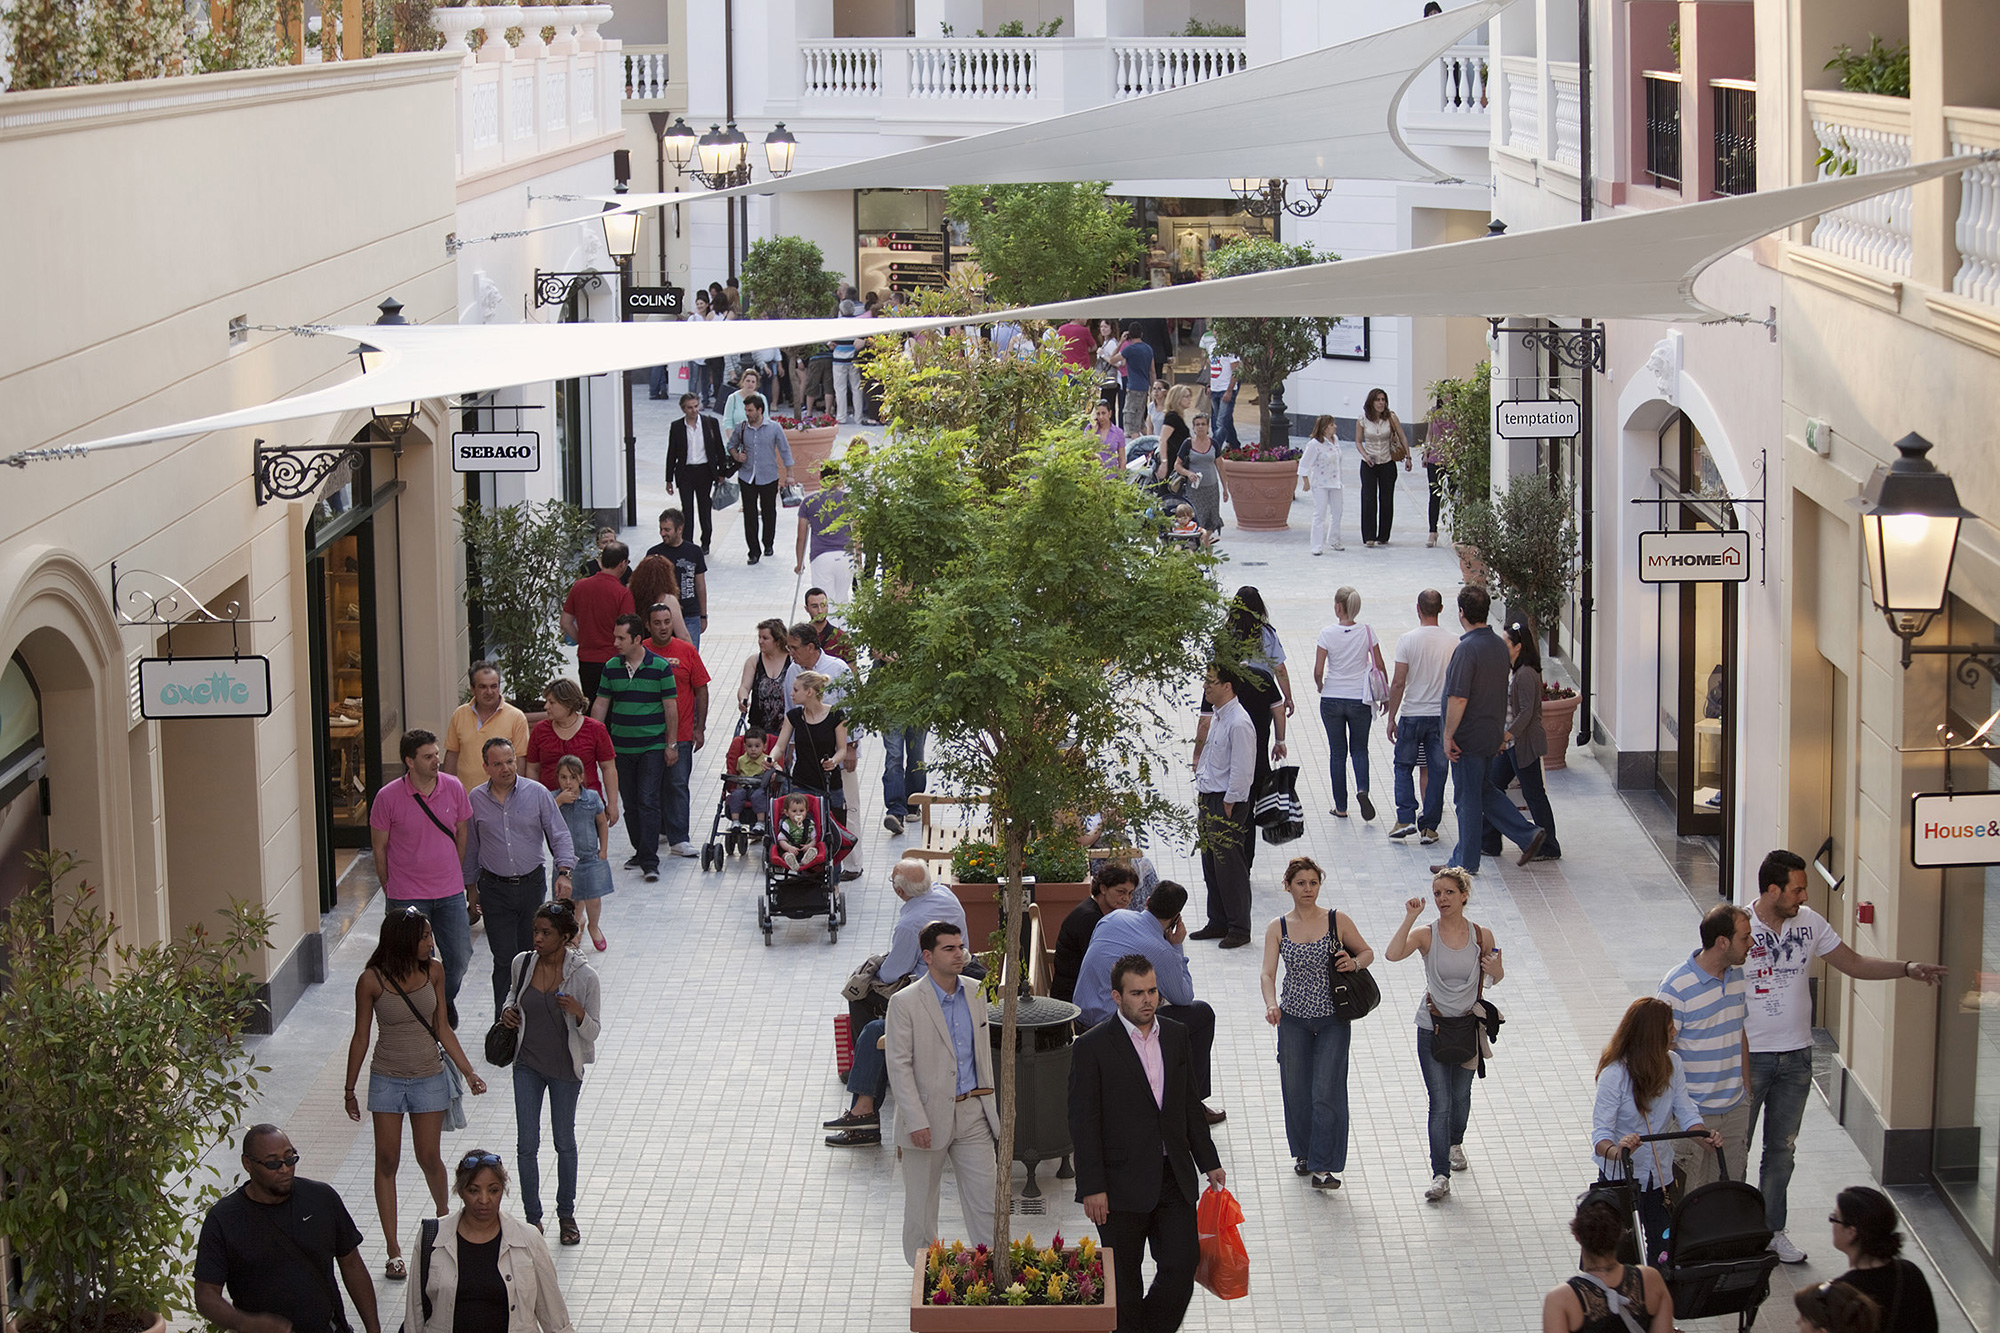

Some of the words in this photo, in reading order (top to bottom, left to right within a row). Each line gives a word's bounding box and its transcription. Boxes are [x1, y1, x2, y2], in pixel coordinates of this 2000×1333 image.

[629, 293, 676, 307] COLIN'S
[1505, 412, 1573, 427] temptation
[460, 446, 531, 459] SEBAGO
[1648, 555, 1722, 567] MYHOME
[160, 671, 250, 705] oxette
[1924, 820, 2000, 839] House&
